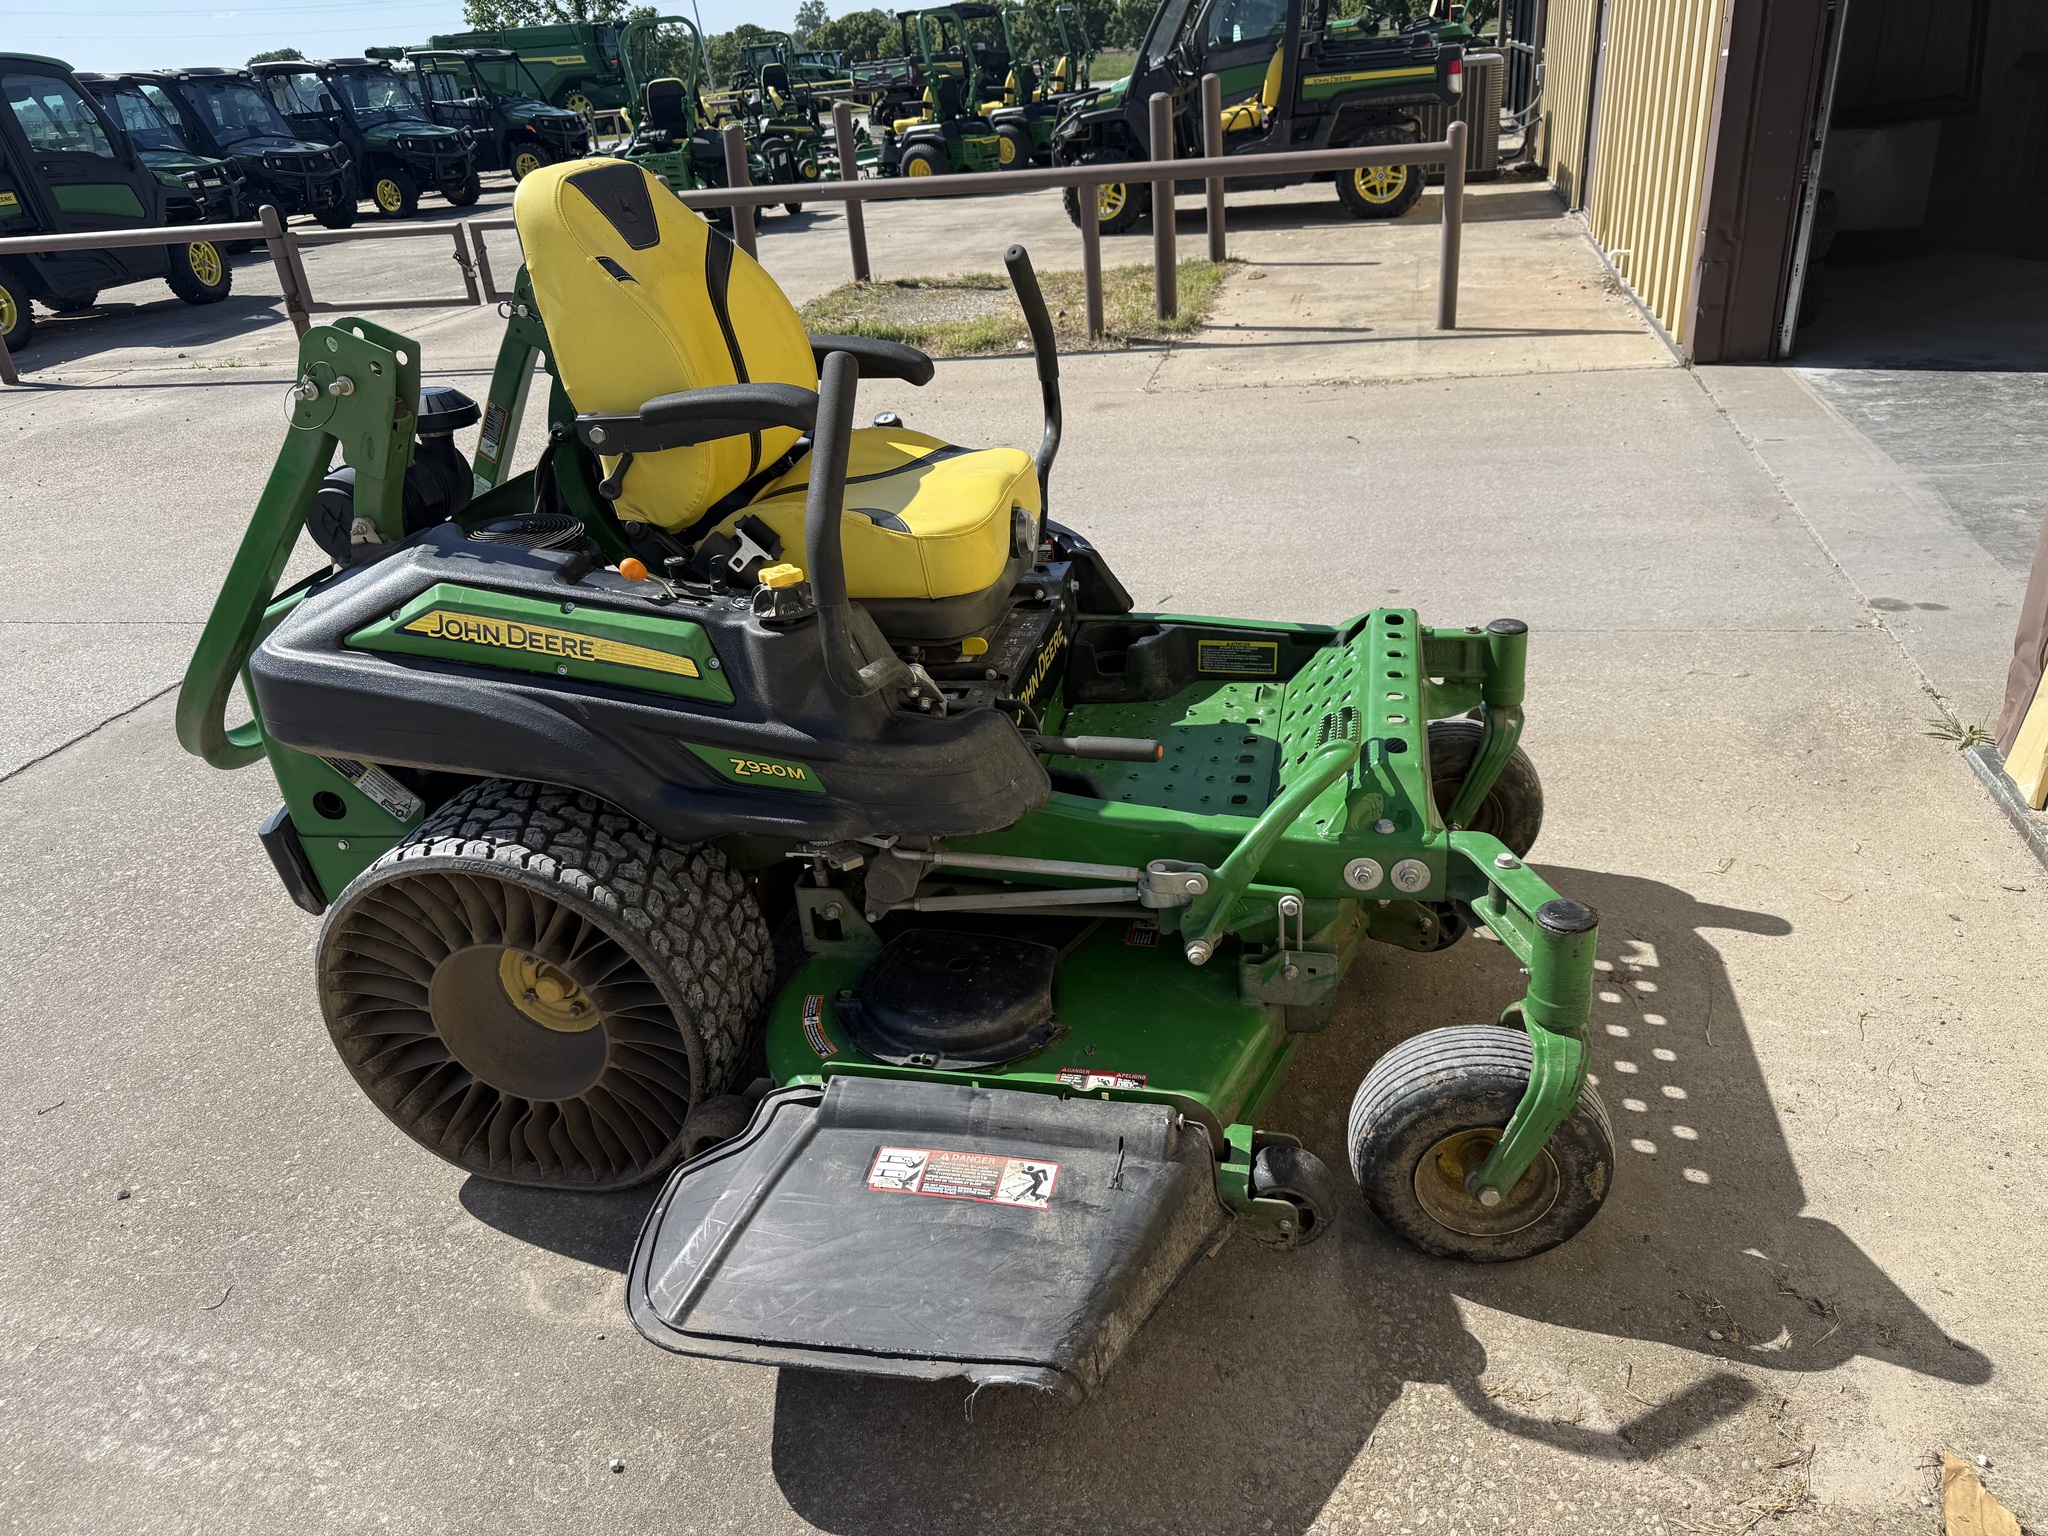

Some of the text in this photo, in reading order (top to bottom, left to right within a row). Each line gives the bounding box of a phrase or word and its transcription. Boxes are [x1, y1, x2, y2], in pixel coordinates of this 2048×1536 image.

[430, 614, 595, 659] JOHN DEERE
[1038, 620, 1064, 681] DEERE
[729, 758, 806, 780] Z930M
[450, 858, 522, 881] MICHELIN
[952, 1153, 996, 1164] DANGER
